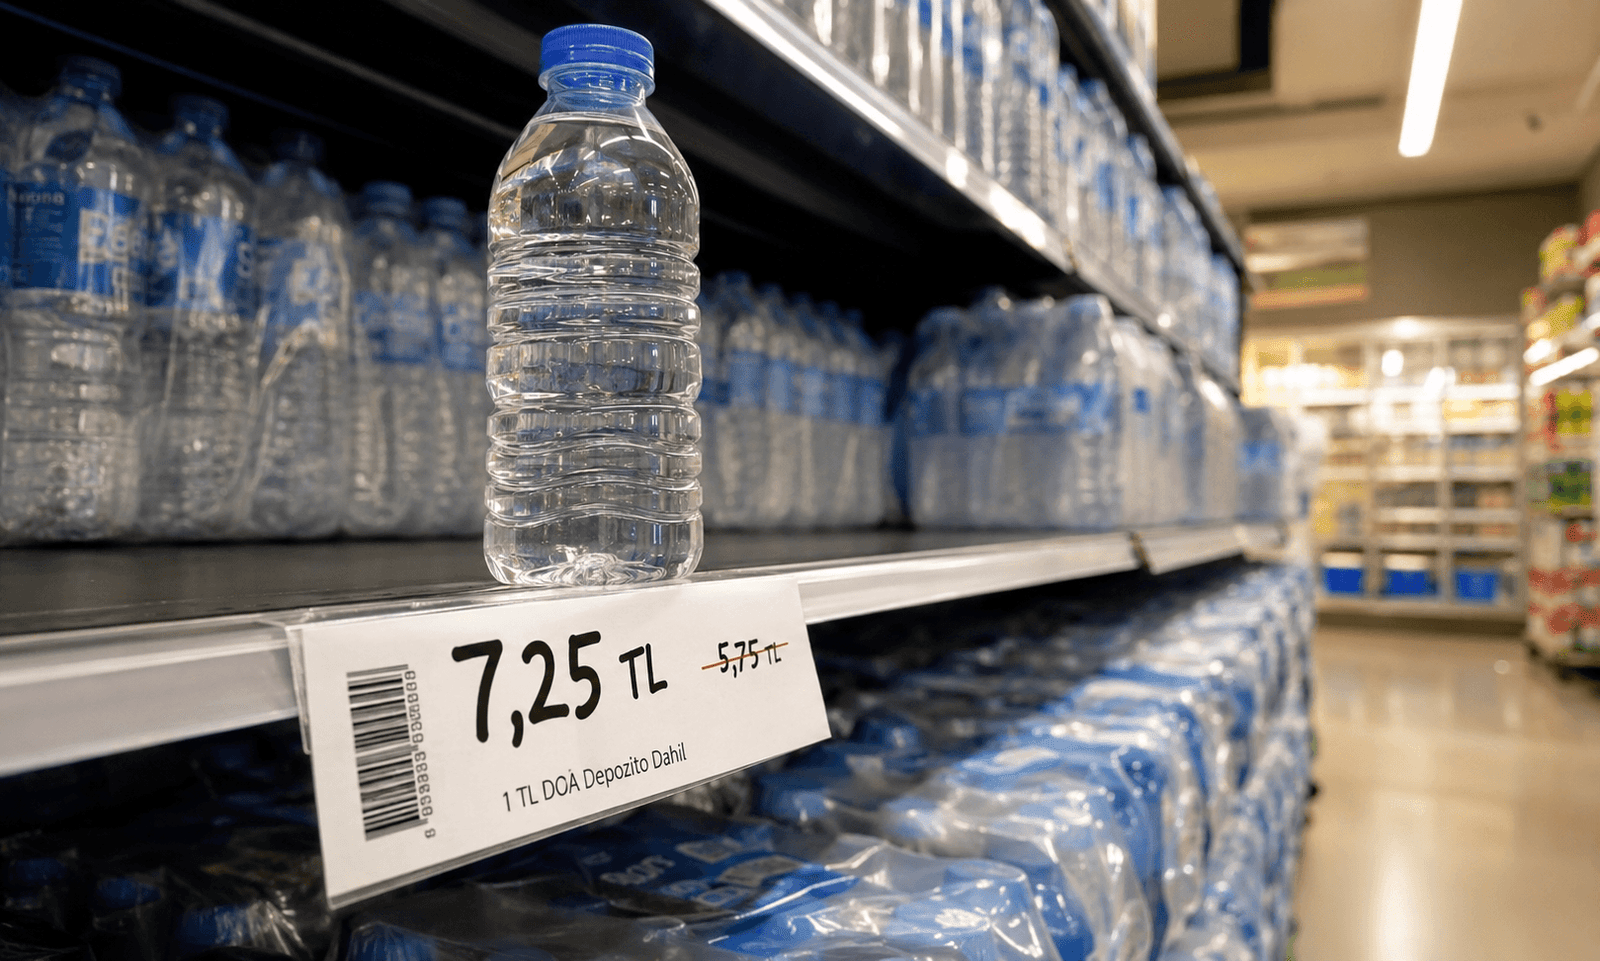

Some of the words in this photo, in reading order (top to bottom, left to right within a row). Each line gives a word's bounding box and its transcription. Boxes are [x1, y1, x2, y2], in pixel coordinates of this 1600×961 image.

[451, 630, 603, 749] 7,25
[618, 643, 668, 701] TL
[717, 638, 759, 679] 5,75
[764, 641, 783, 665] TL
[502, 790, 512, 813] 1
[516, 785, 540, 808] TL
[582, 757, 650, 789] Depozito
[651, 741, 688, 770] Dahil
